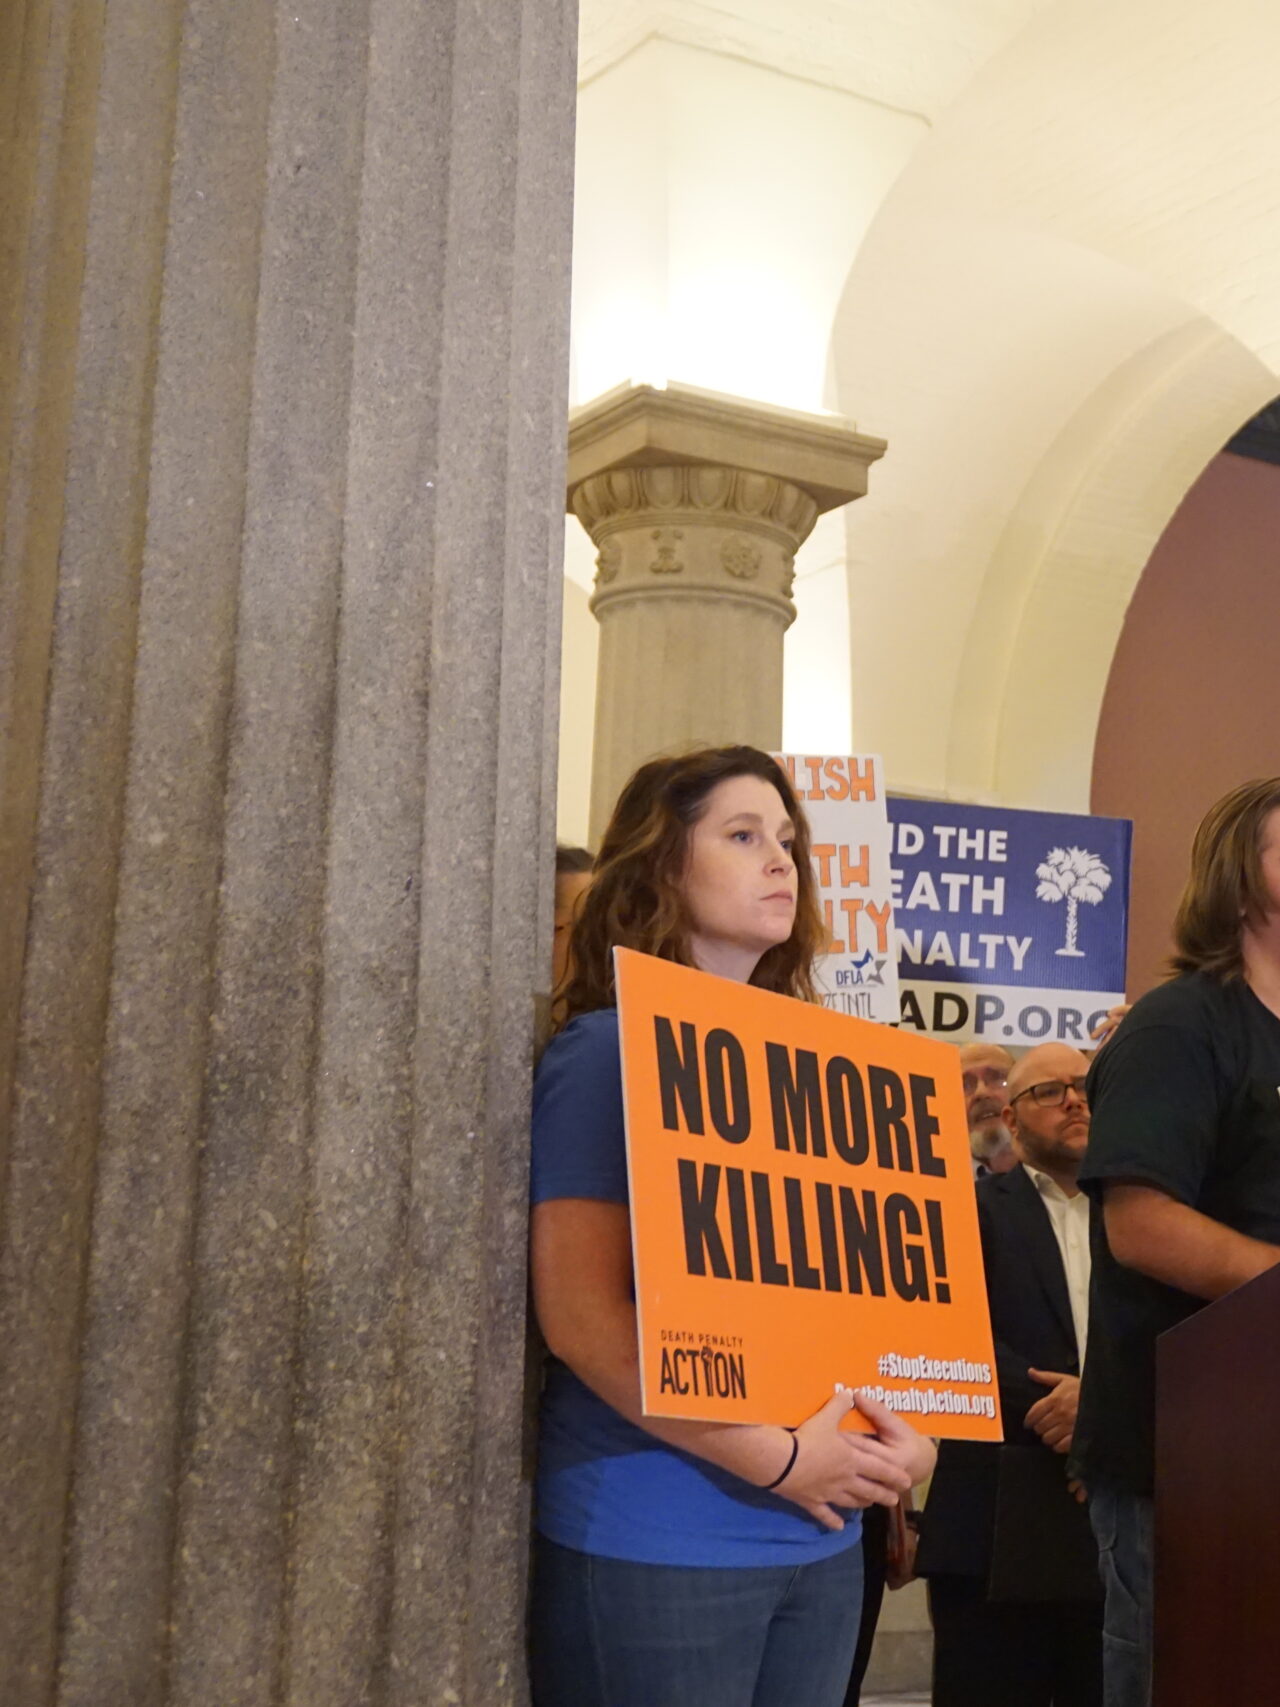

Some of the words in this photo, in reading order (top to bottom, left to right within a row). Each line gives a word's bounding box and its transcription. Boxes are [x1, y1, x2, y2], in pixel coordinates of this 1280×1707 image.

[933, 826, 1008, 862] THE
[836, 970, 864, 985] DFLA
[654, 1015, 751, 1144] NO
[765, 1041, 947, 1178] MORE
[677, 1158, 951, 1304] KILLING!
[661, 1329, 694, 1343] DEATH
[699, 1333, 743, 1348] PENALTY
[660, 1345, 746, 1399] ACTION
[877, 1352, 992, 1384] #StopExecutions
